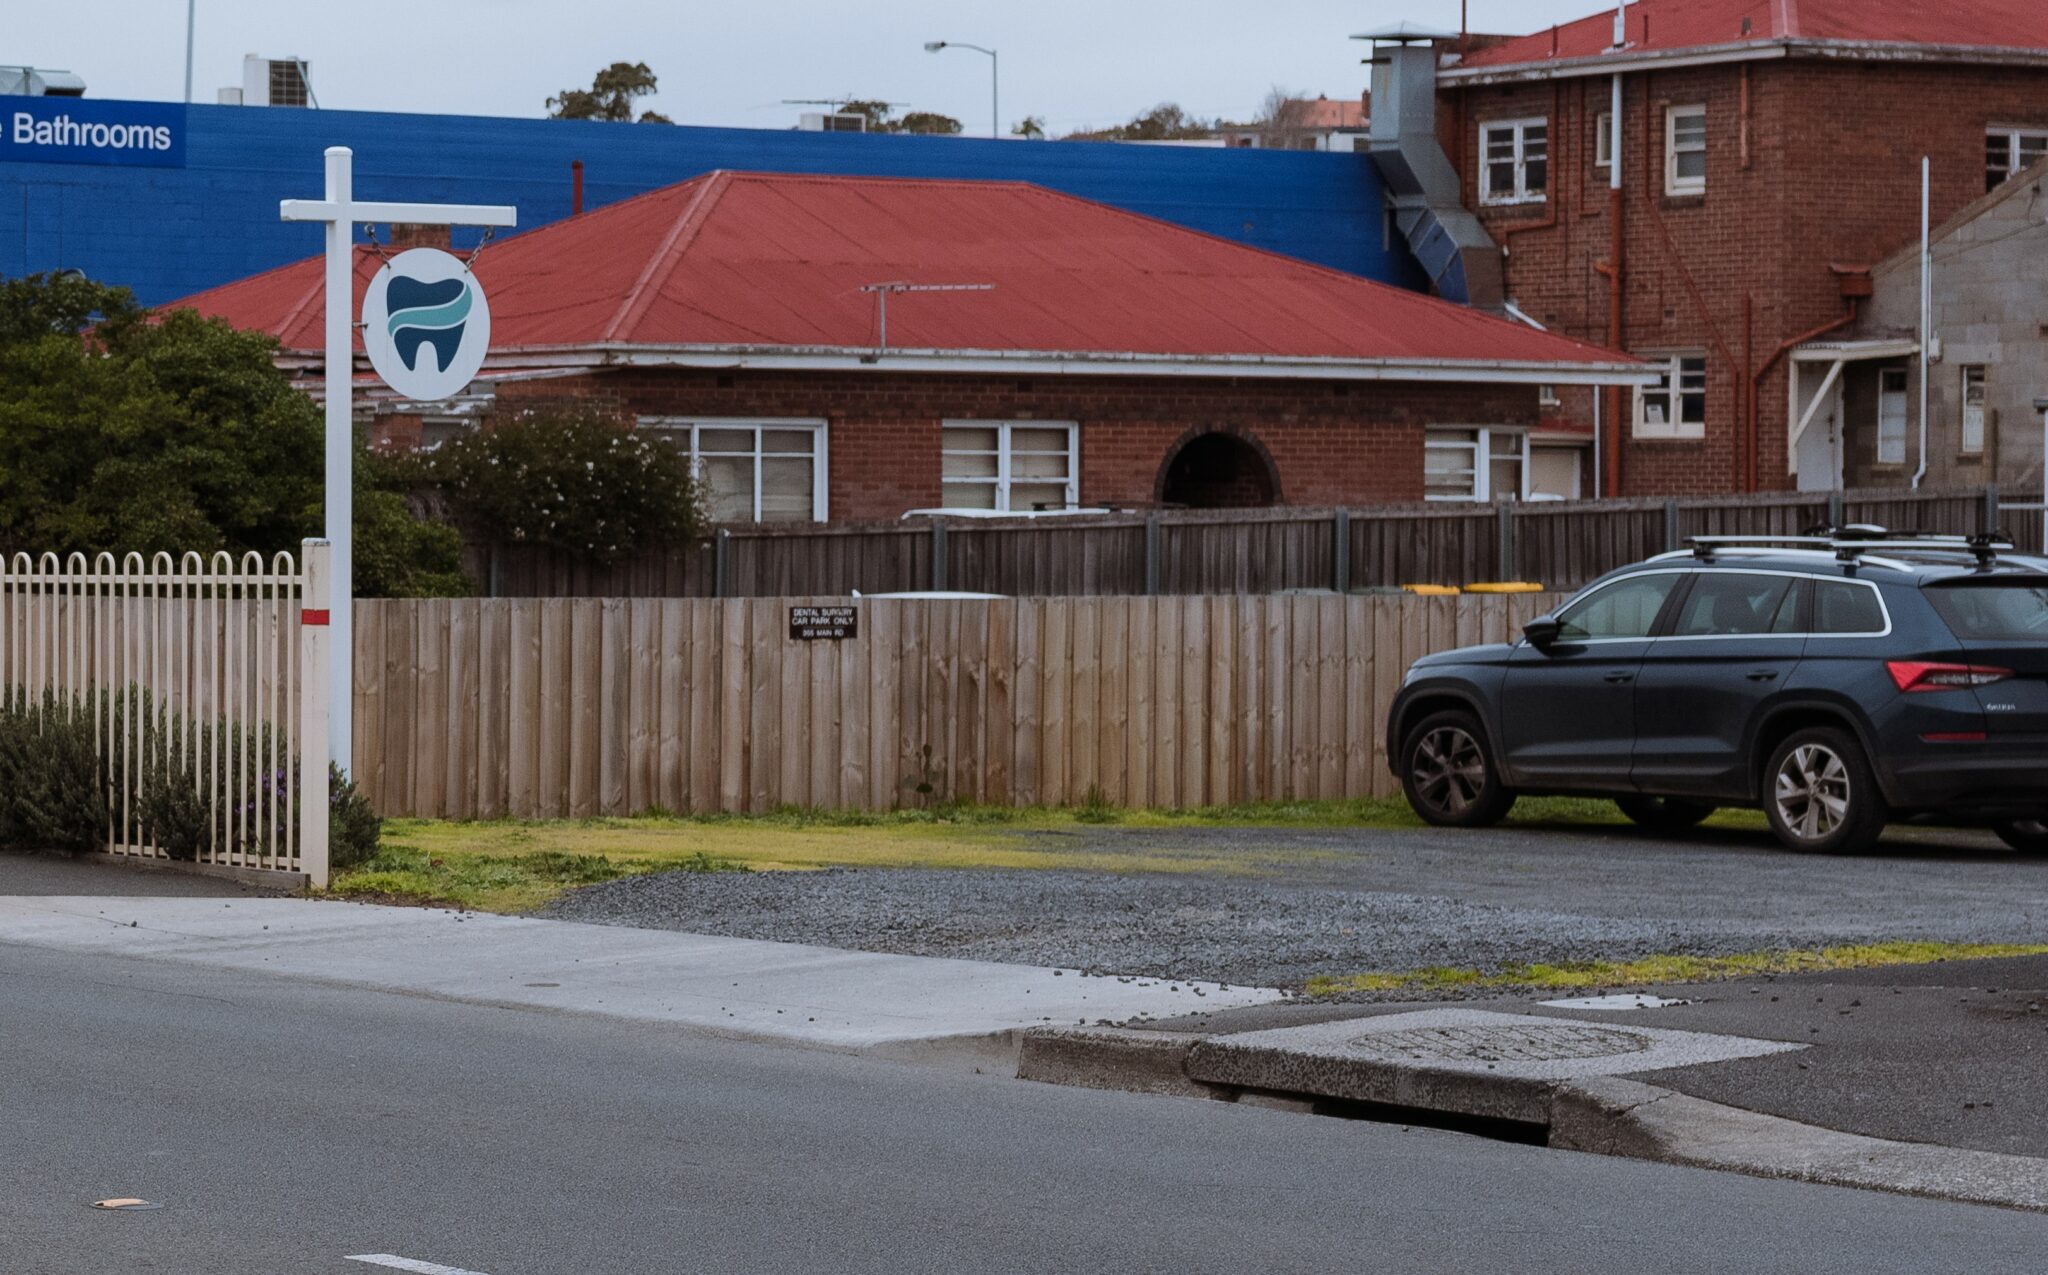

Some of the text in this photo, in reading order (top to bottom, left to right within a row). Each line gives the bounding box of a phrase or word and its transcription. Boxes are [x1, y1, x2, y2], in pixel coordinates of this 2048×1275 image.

[13, 112, 172, 151] Bathrooms
[793, 608, 819, 617] DENTAL
[792, 617, 854, 626] CAR PARK ONLY
[816, 629, 832, 637] MAIN
